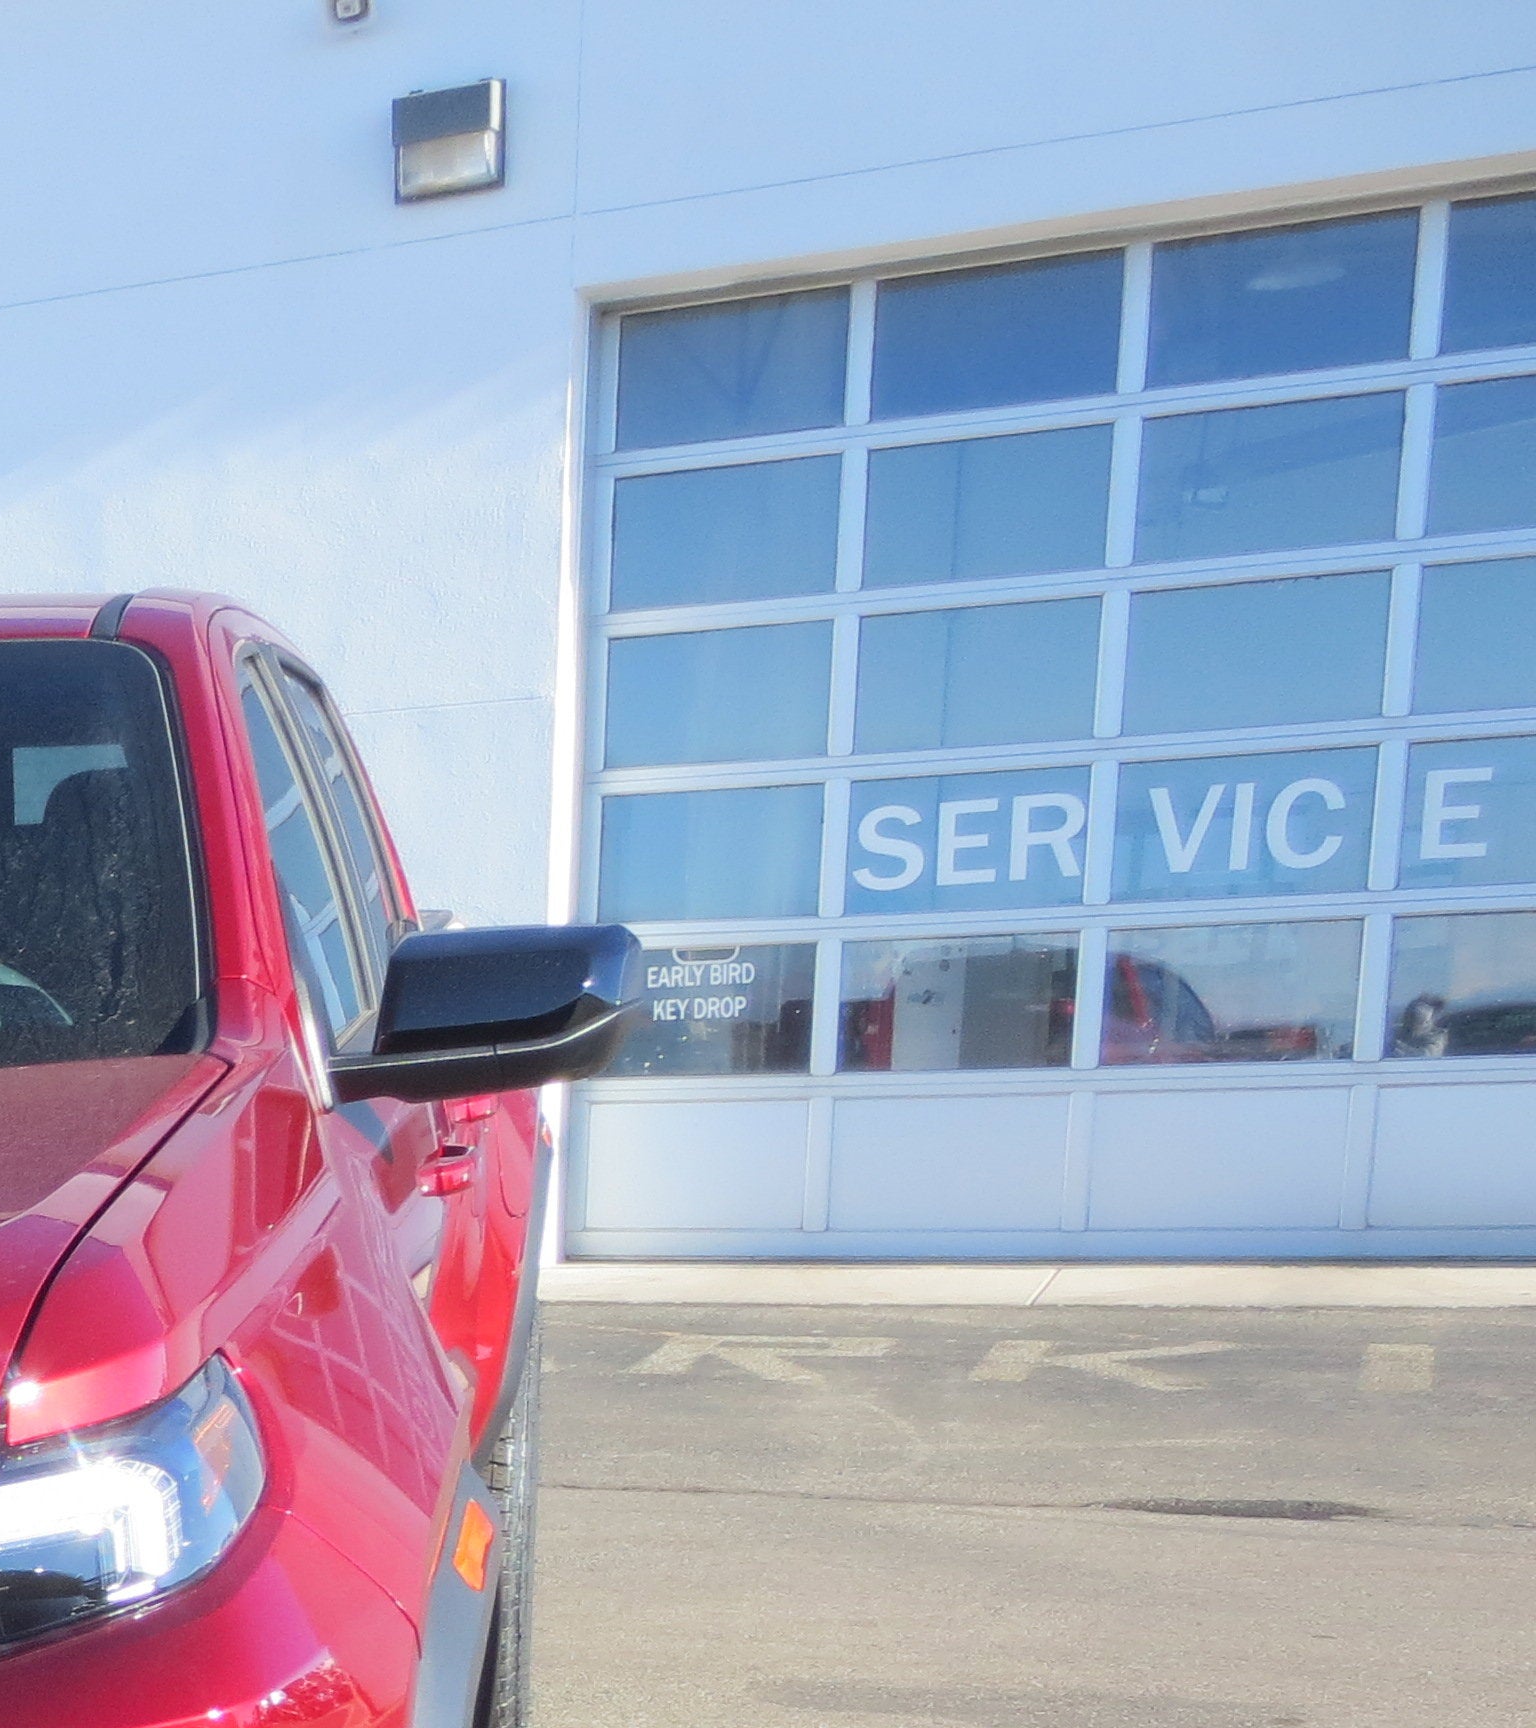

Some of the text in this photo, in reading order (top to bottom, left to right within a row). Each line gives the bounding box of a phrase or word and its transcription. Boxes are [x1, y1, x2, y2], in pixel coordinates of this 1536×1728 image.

[852, 766, 1494, 891] SERVICE
[647, 962, 756, 988] EARLY BIRD
[652, 996, 747, 1021] KEY DROP
